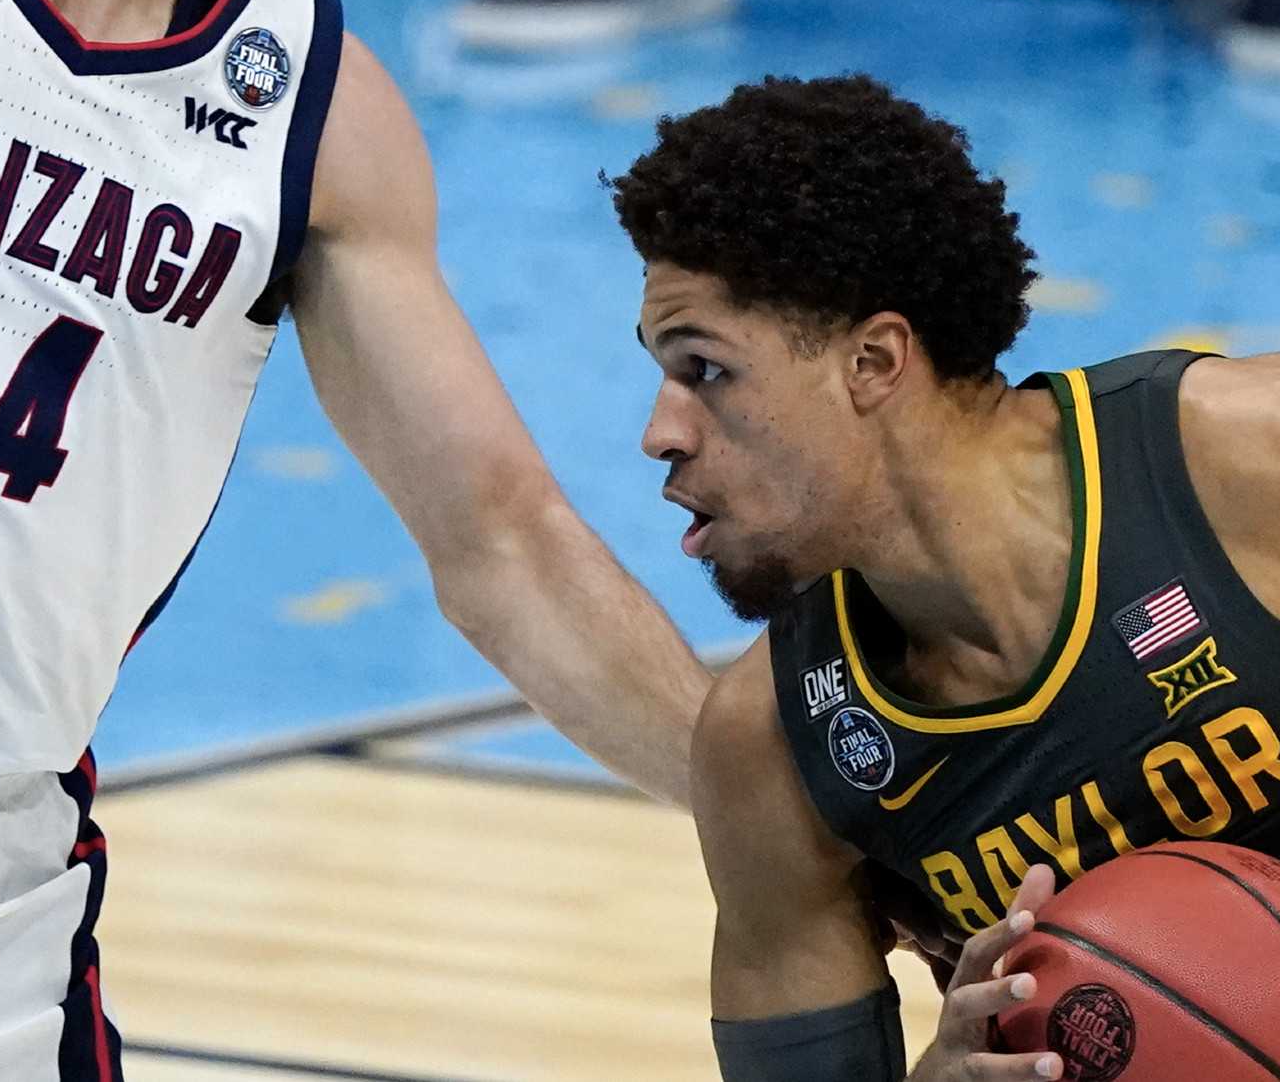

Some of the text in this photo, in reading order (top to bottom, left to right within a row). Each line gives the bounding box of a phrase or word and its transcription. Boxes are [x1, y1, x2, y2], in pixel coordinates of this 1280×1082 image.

[239, 45, 279, 72] FINAL
[236, 64, 275, 93] FOUR
[184, 96, 258, 150] WCC
[804, 658, 845, 706] ONE
[839, 726, 874, 754] FINAL
[848, 745, 883, 773] FOUR
[1069, 1004, 1120, 1045] FOUR
[1063, 1028, 1109, 1069] FINAL
